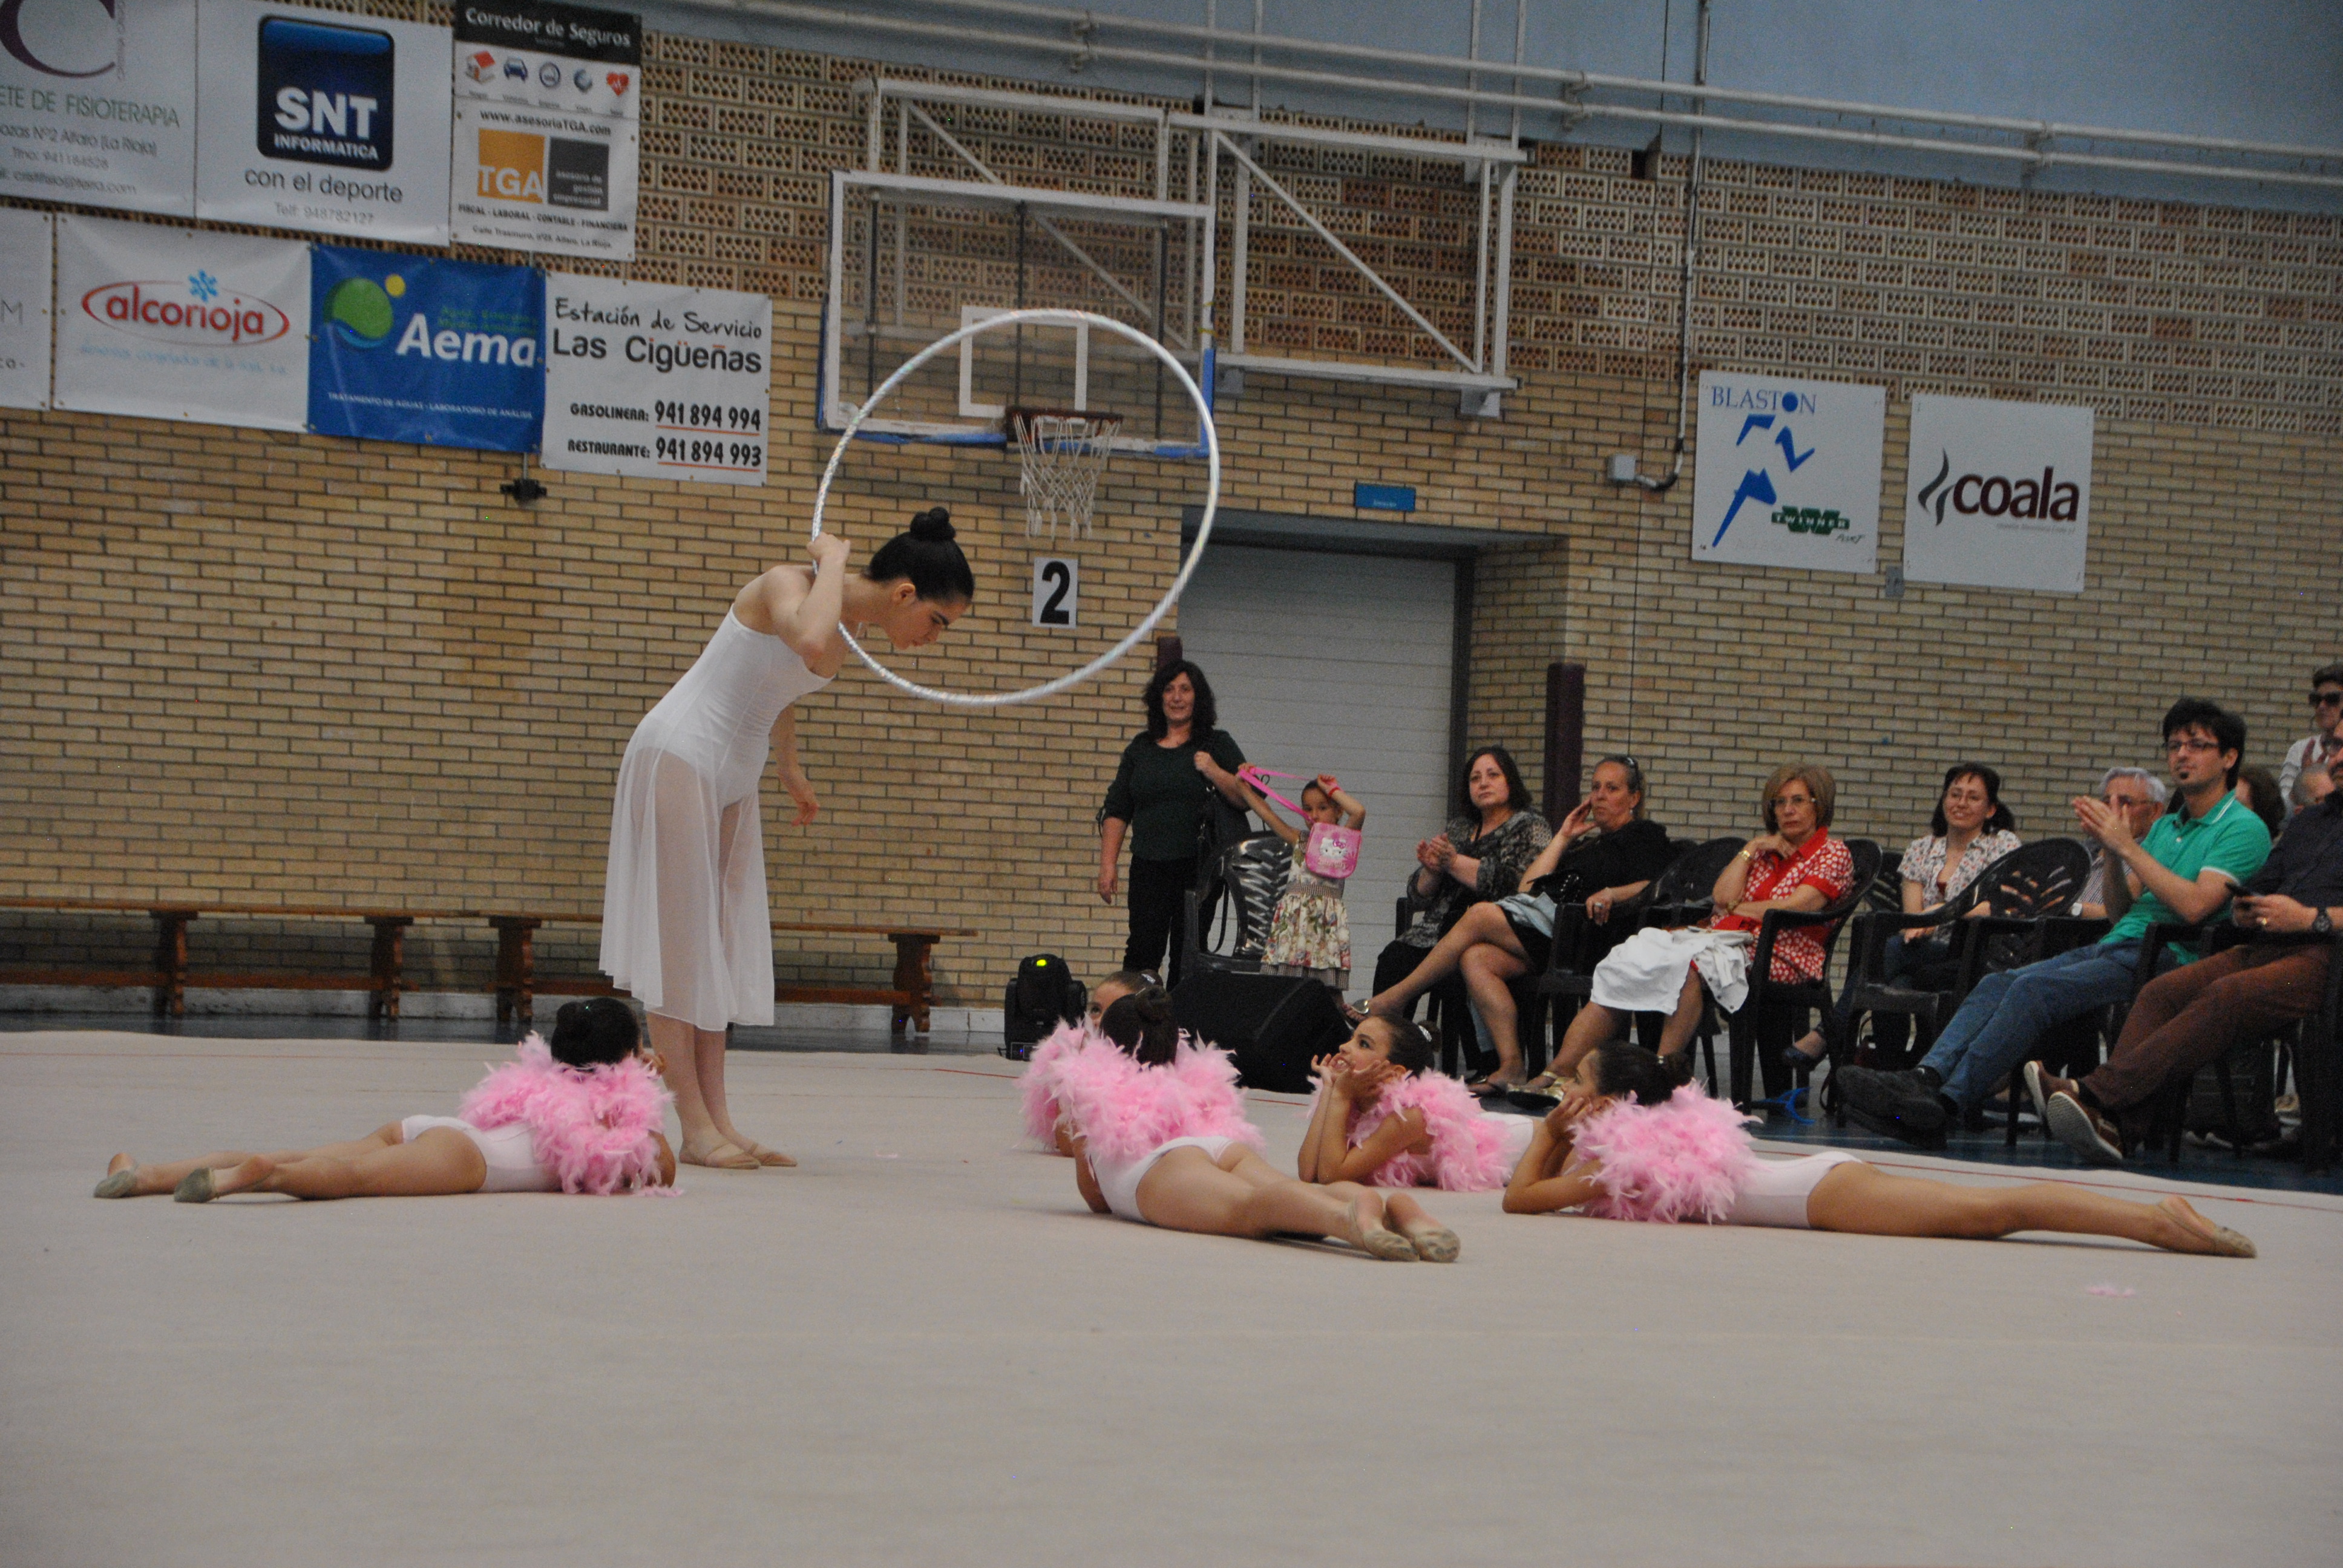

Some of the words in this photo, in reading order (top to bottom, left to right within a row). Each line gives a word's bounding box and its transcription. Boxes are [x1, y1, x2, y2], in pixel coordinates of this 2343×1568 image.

[465, 7, 541, 33] Corredor
[546, 19, 564, 38] de
[569, 22, 631, 48] Seguros
[32, 90, 56, 113] DE
[65, 93, 180, 128] FISIOTERAPIA
[275, 87, 378, 140] SNT
[274, 133, 379, 160] INFORMATICA
[244, 168, 286, 189] con
[293, 171, 312, 193] el
[320, 174, 403, 203] deporte
[478, 165, 543, 198] TGA
[458, 203, 487, 216] FISCAL
[493, 209, 531, 221] LABORAL
[537, 214, 575, 227] CONTABLE
[581, 219, 629, 232] FINANCIERA
[106, 283, 264, 342] alcorioja
[555, 297, 640, 327] Estación
[650, 309, 675, 330] de
[683, 311, 762, 339] Servicio
[396, 313, 536, 368] Aema
[553, 328, 607, 359] Las
[625, 334, 762, 373] Cigüeñas
[570, 402, 649, 422] GASOLINERA:
[655, 399, 685, 425] 941
[690, 403, 723, 428] 894
[728, 406, 761, 431] 994
[1711, 386, 1816, 414] BLASTON
[568, 438, 650, 459] RESTAURANTE:
[655, 436, 686, 461] 941
[690, 439, 724, 465] 894
[730, 442, 762, 467] 993
[1953, 466, 2080, 521] coala
[1774, 512, 1847, 530] TWINNER
[1038, 561, 1070, 624] 2
